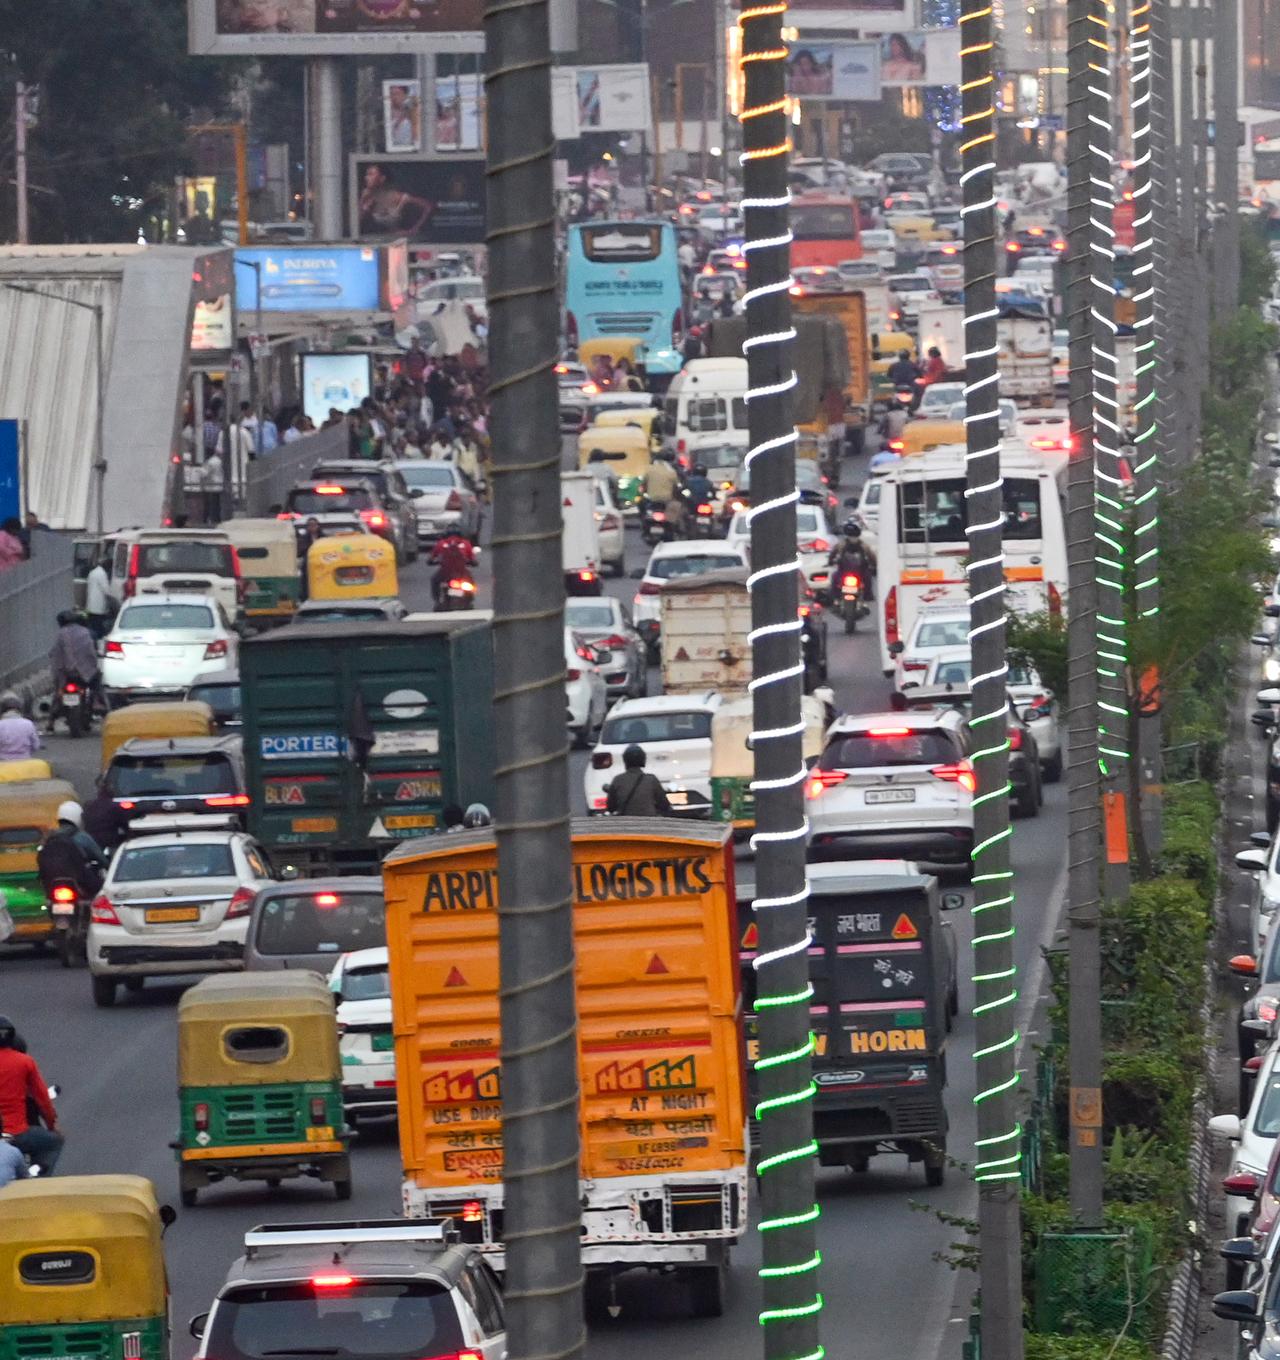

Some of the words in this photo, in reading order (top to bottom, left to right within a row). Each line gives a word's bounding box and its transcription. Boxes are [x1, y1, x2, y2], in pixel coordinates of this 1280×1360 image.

[261, 735, 338, 752] PORTER
[423, 871, 500, 912] ARPI
[575, 857, 712, 904] LOGISTICS
[450, 1038, 495, 1049] GOODS
[851, 1030, 927, 1054] HORN
[596, 1057, 696, 1093] HORN
[433, 1108, 462, 1123] USE
[631, 1096, 649, 1113] AT
[662, 1092, 708, 1111] NIGHT
